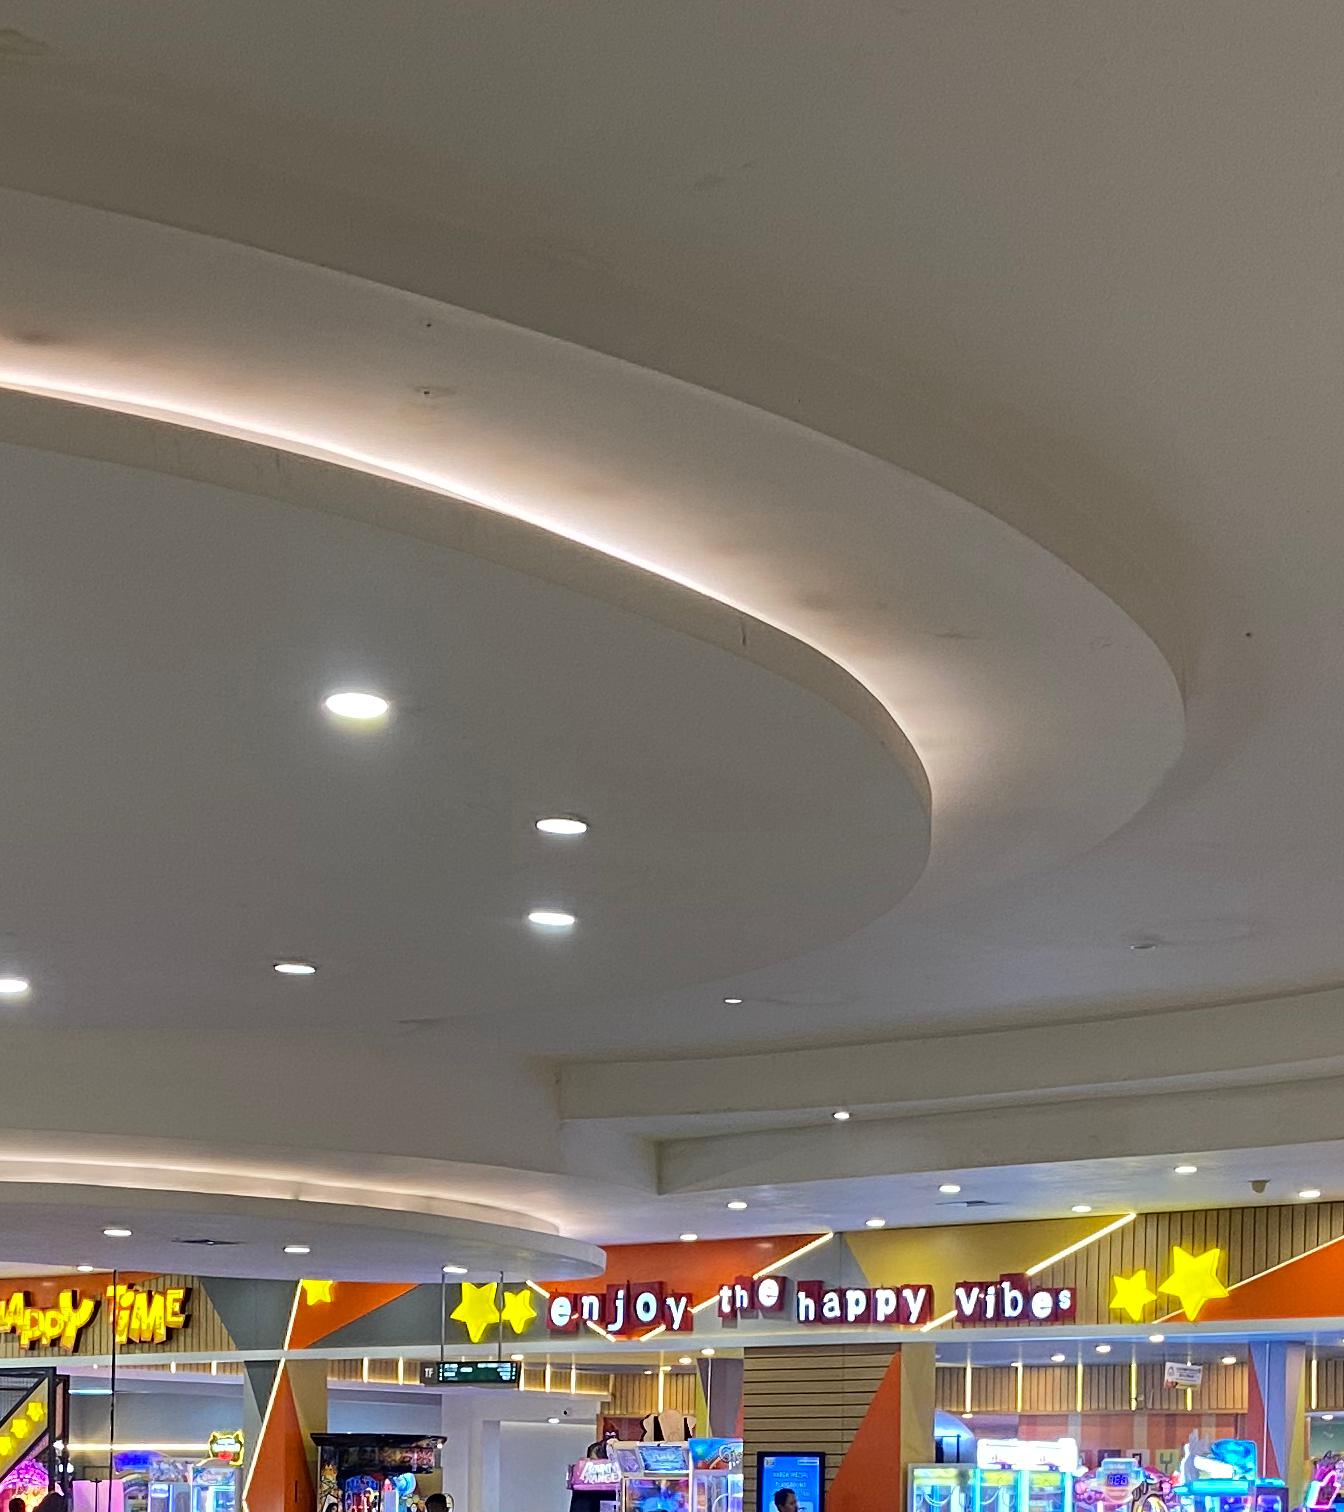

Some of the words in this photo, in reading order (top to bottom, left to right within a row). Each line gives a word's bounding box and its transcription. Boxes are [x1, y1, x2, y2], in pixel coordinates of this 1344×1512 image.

[550, 1289, 687, 1332] enjoy
[719, 1278, 779, 1313] the
[798, 1288, 926, 1323] happy
[956, 1281, 1071, 1319] vibes
